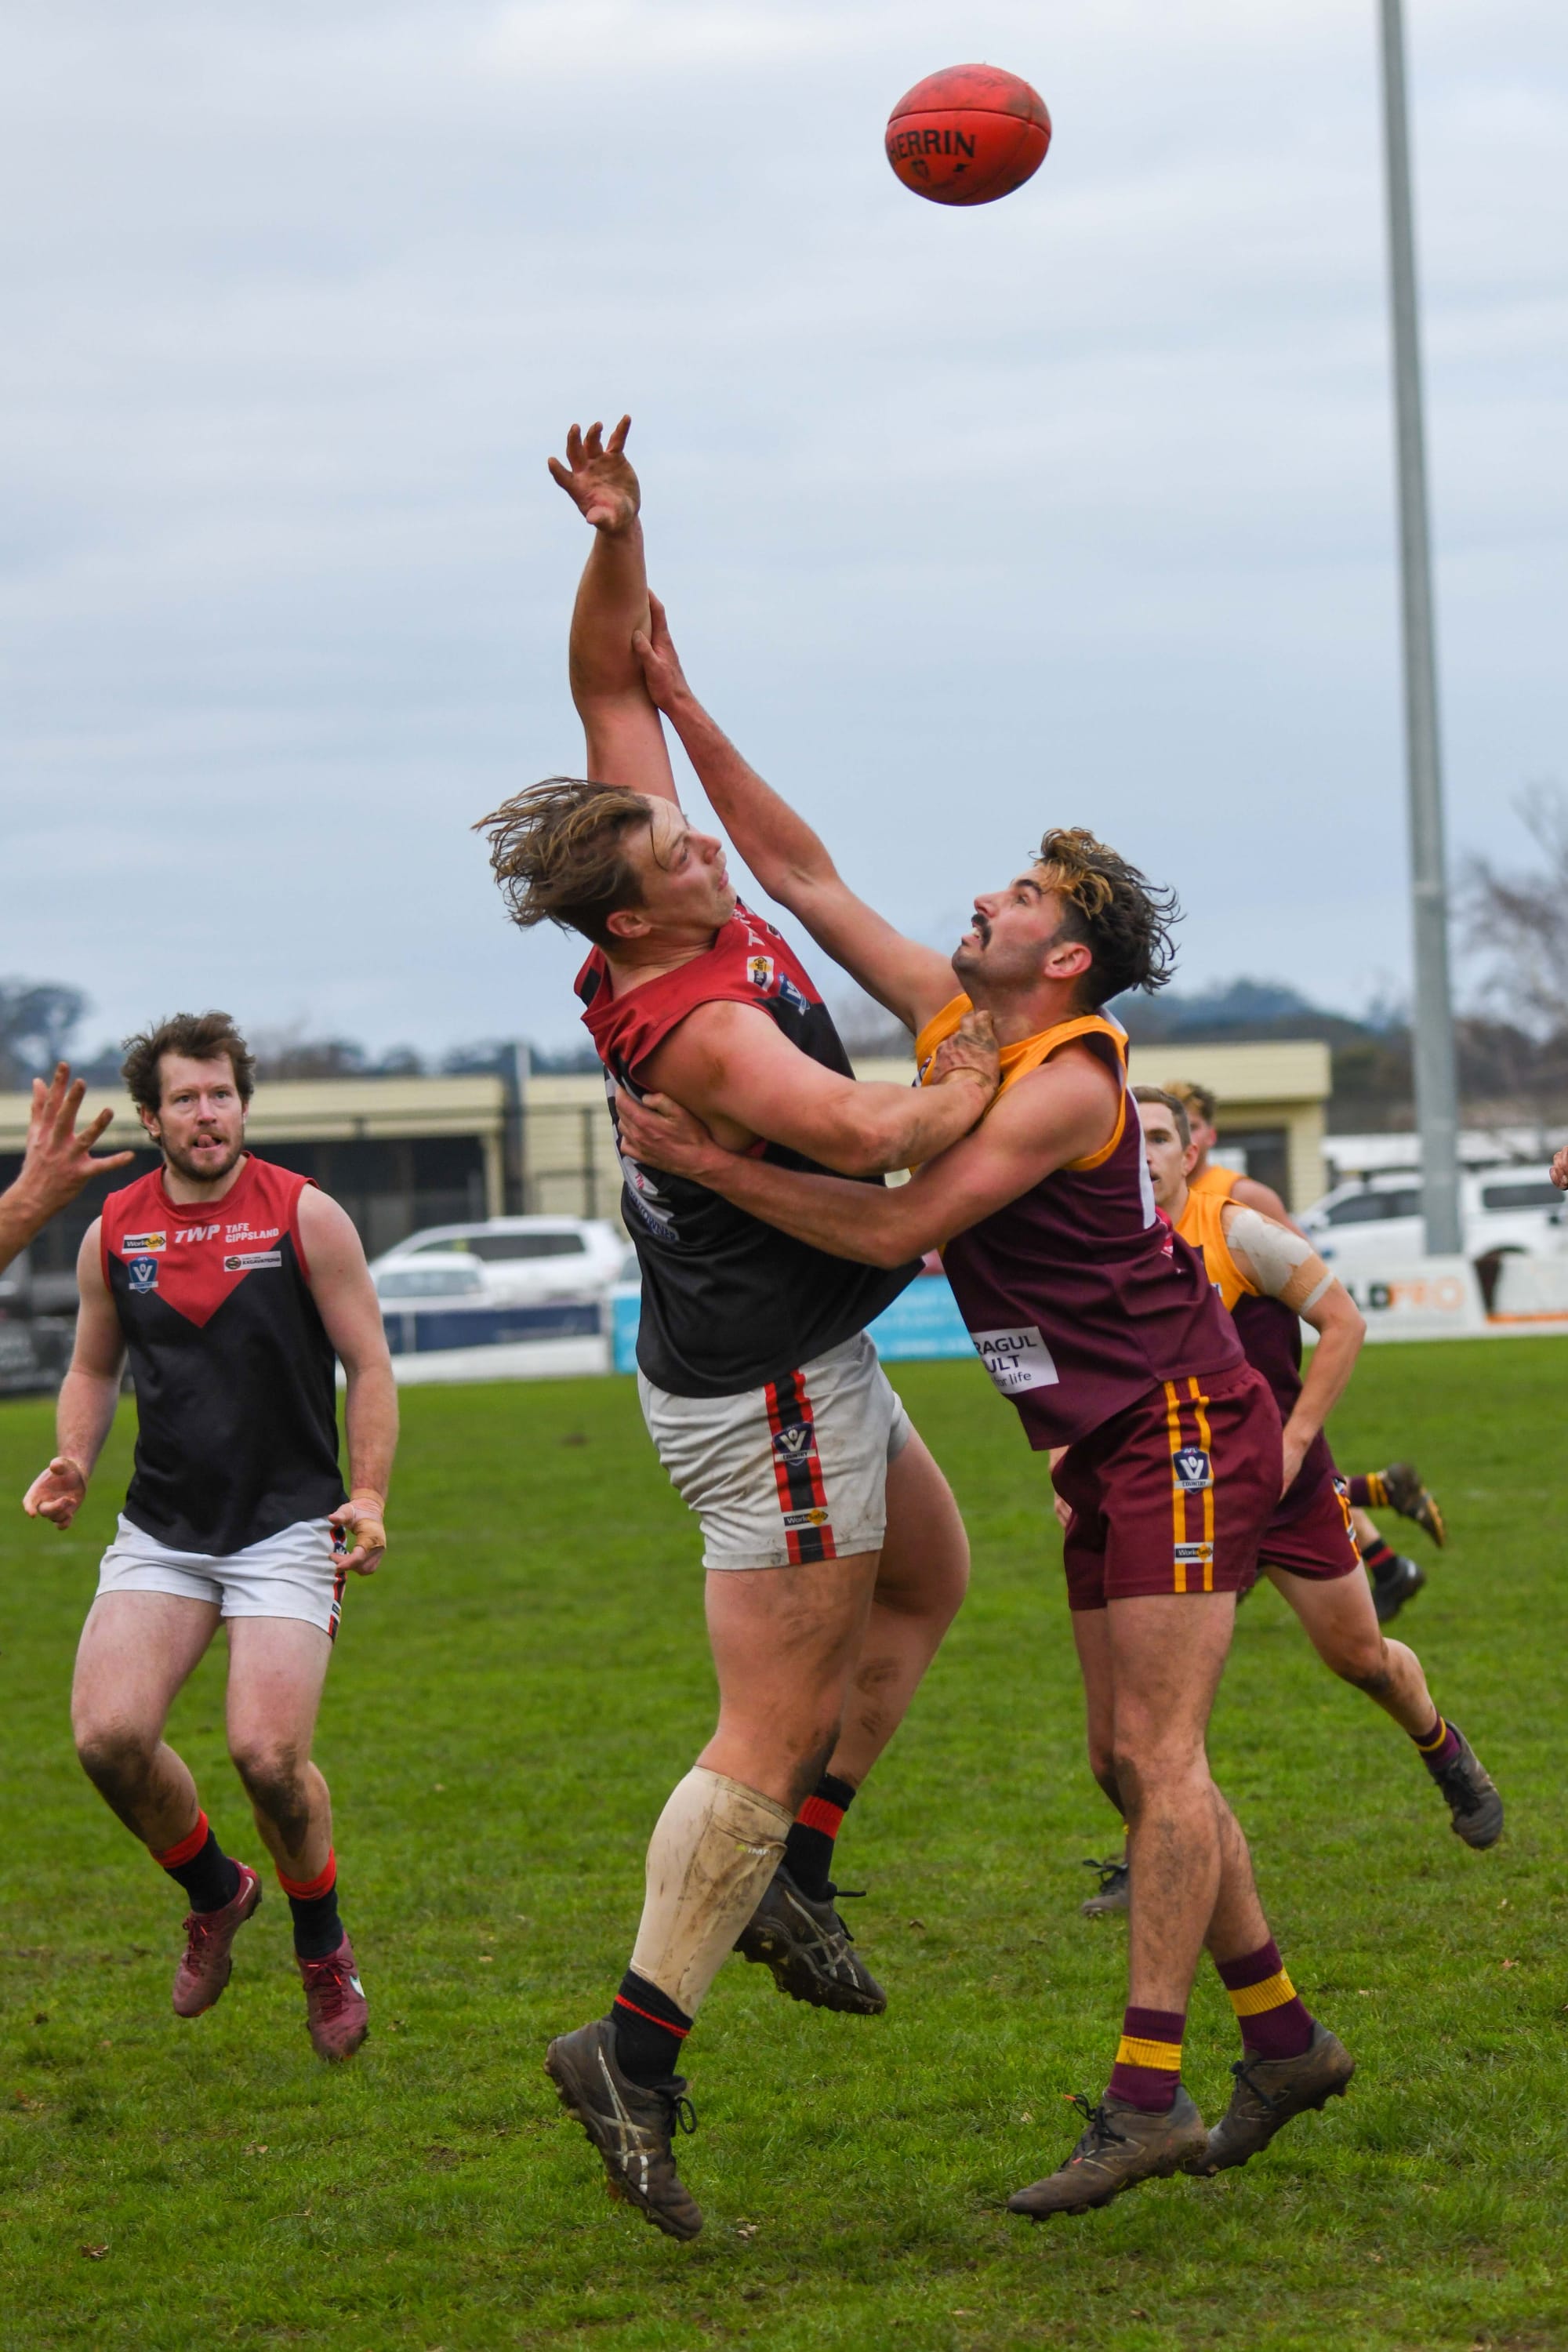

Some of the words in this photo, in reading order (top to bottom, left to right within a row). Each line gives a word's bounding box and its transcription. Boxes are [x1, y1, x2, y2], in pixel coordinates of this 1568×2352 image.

[175, 1224, 220, 1243] TWP
[226, 1223, 249, 1234] TAFE
[226, 1228, 279, 1243] GIPPSLAND
[1009, 1371, 1032, 1385] life
